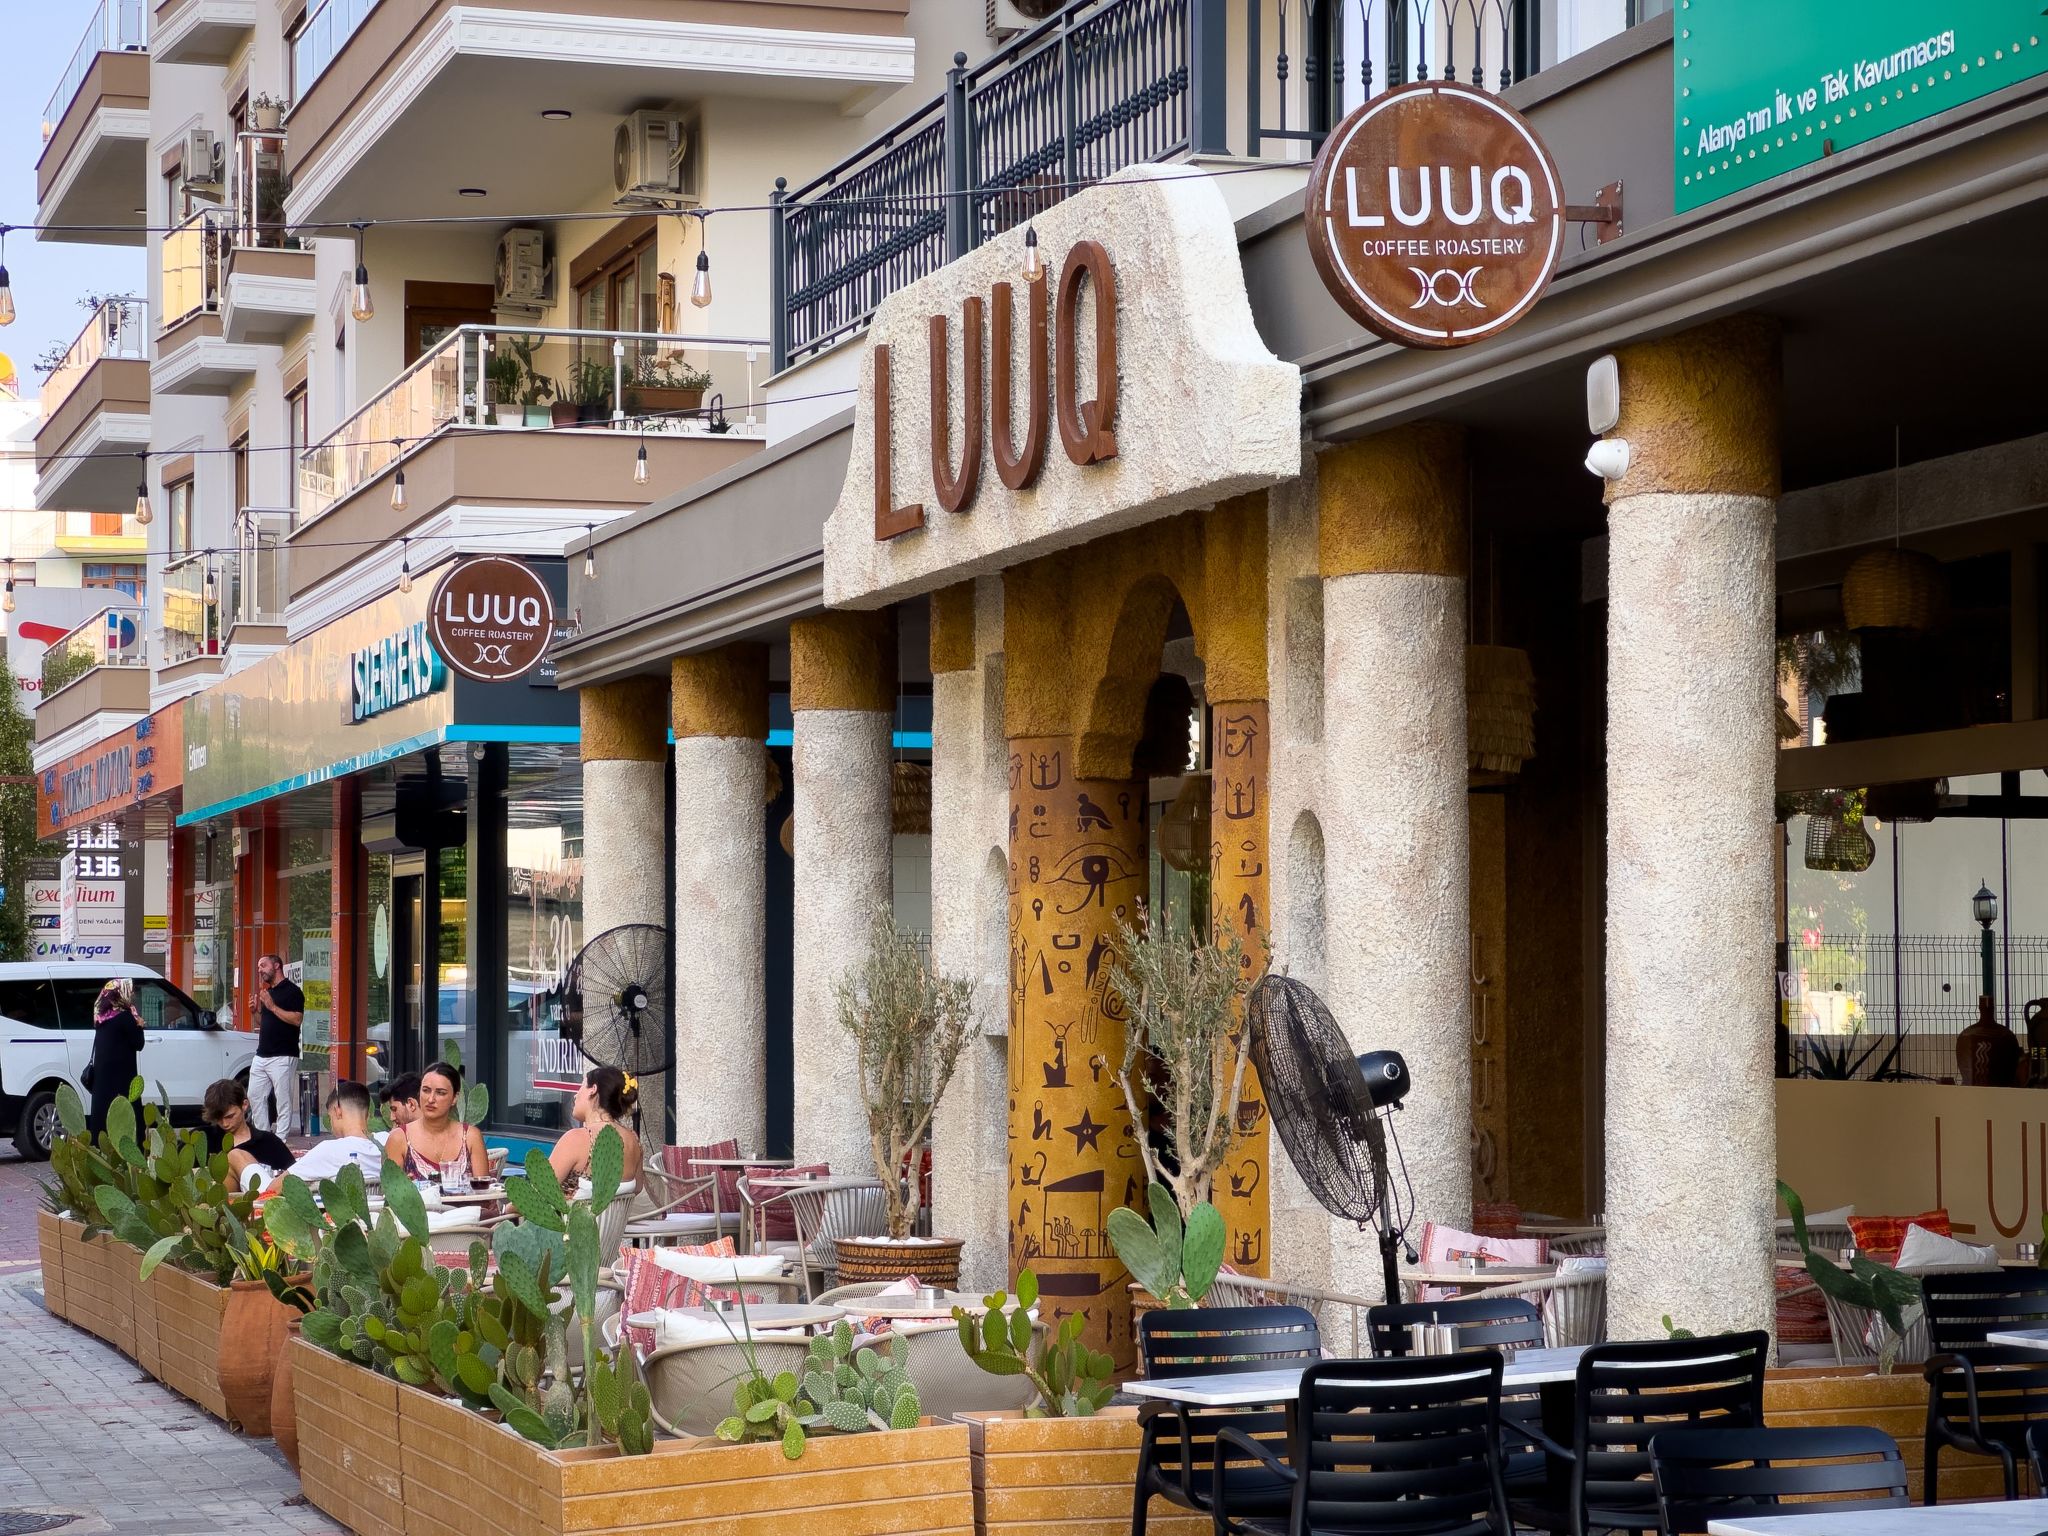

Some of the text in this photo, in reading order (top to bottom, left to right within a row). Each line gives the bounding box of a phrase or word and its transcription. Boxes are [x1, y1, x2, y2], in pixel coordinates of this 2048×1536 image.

[1697, 30, 1955, 157] Alanya'nın İlk ve Tek Kavurmacısı
[1345, 165, 1536, 227] LUUQ
[1363, 238, 1524, 256] COFFEE ROASTERY
[874, 240, 1118, 542] LUUQ
[445, 592, 541, 627] LUUQ
[451, 627, 534, 641] COFFEE ROASTERY
[354, 621, 432, 719] SIEMENS
[96, 744, 133, 804] MOTOR
[75, 856, 120, 877] 3.36
[35, 887, 115, 903] exclium
[50, 943, 112, 959] Milngaz
